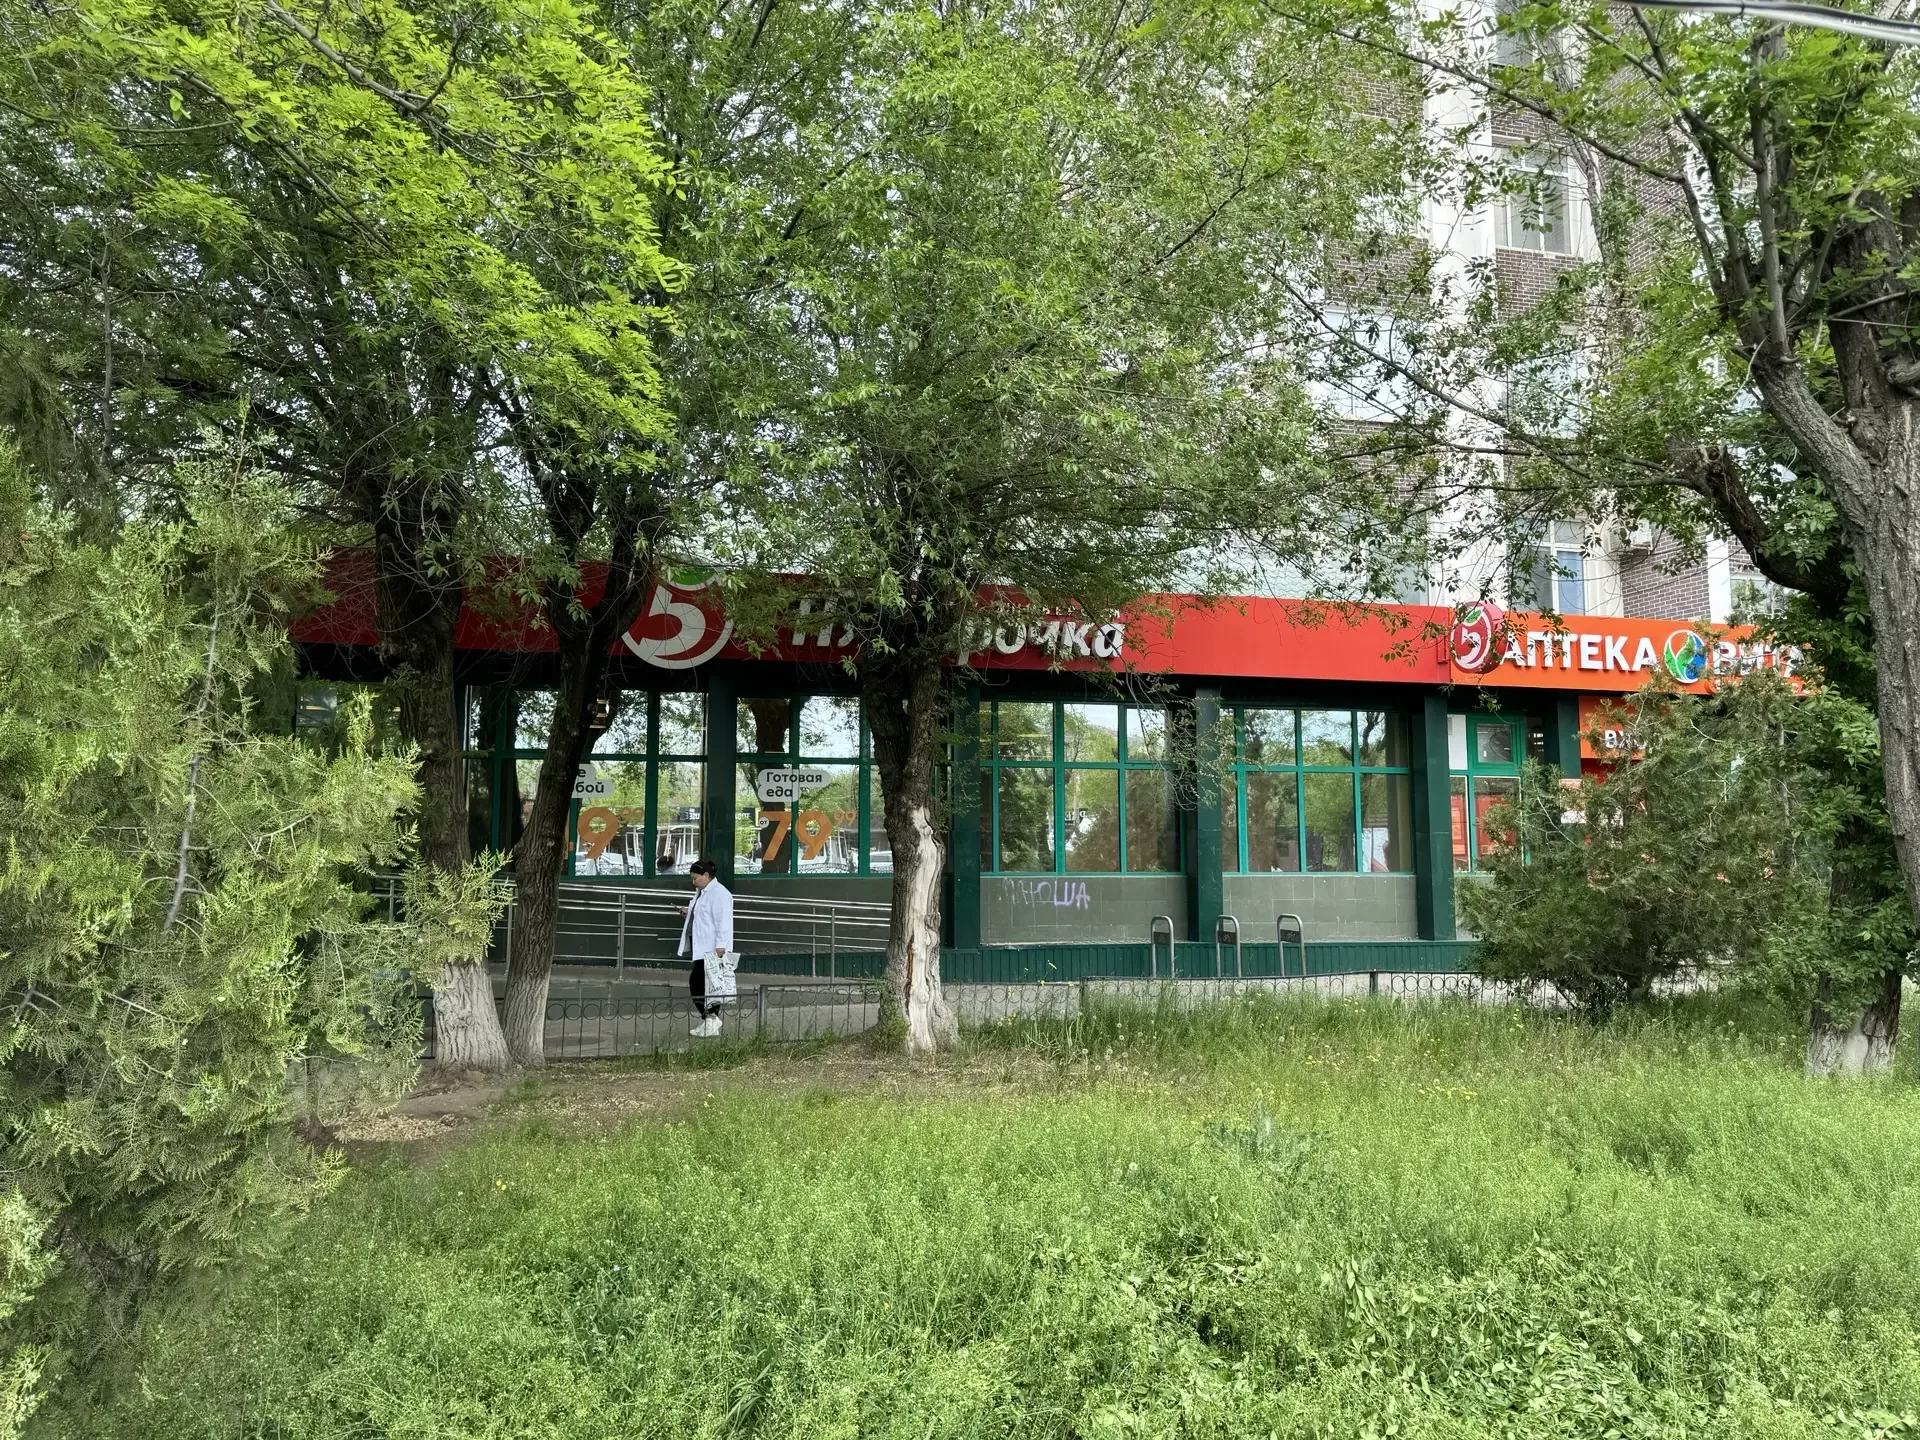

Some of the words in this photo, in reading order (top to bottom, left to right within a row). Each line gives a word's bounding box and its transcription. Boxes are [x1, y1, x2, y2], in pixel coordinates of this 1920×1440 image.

[634, 582, 708, 660] 5
[792, 594, 1126, 666] Прочка
[1500, 631, 1662, 673] АПТЕКА
[575, 781, 605, 793] бой
[766, 772, 822, 783] Готовая
[766, 786, 793, 797] еда
[564, 807, 619, 859] 9
[760, 810, 832, 861] 79
[833, 808, 857, 826] 99
